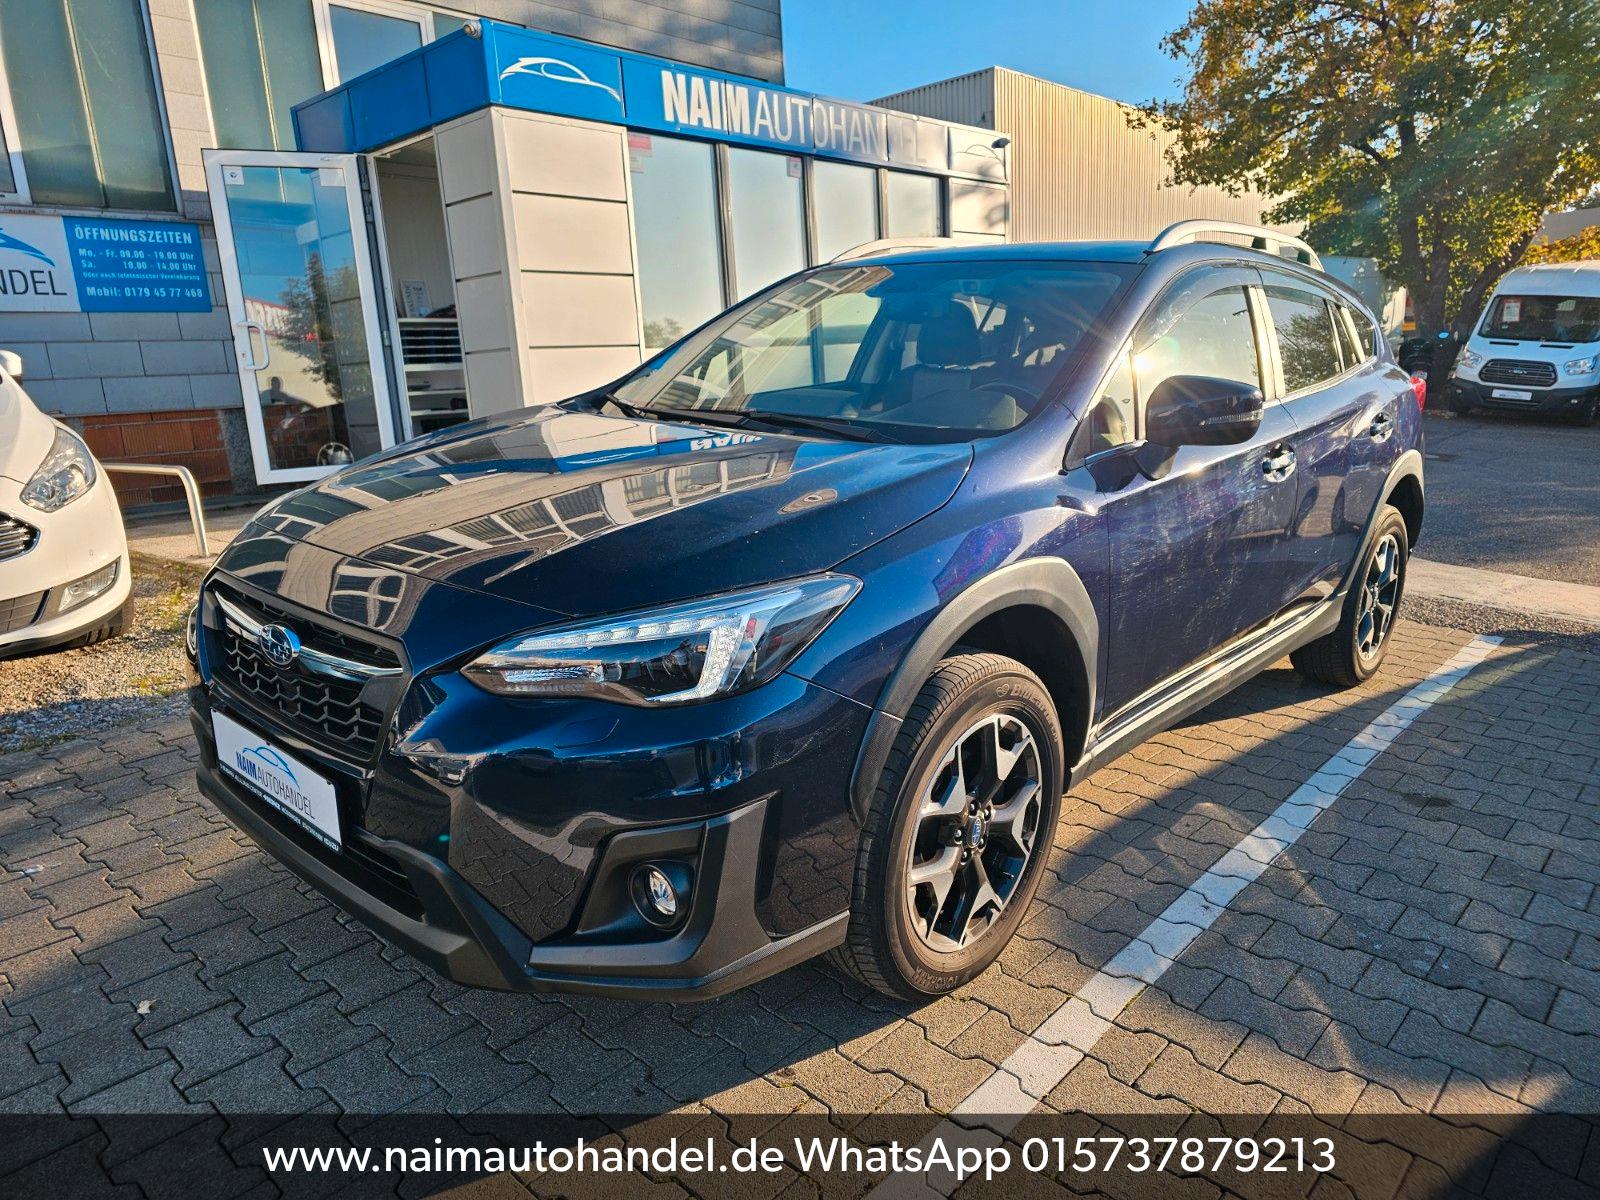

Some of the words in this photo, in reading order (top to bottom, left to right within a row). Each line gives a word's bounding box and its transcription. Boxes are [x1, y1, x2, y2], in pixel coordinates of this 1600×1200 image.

[661, 70, 927, 163] NAIMAUTOHANEL
[75, 224, 192, 244] ÖFFNUNGSZEITEN
[180, 252, 194, 260] Uhr
[81, 259, 96, 269] Sa.
[182, 263, 196, 271] Uhr
[86, 286, 122, 297] Mobil:
[124, 287, 151, 297] 0179
[154, 287, 166, 298] 45
[169, 288, 181, 298] 77
